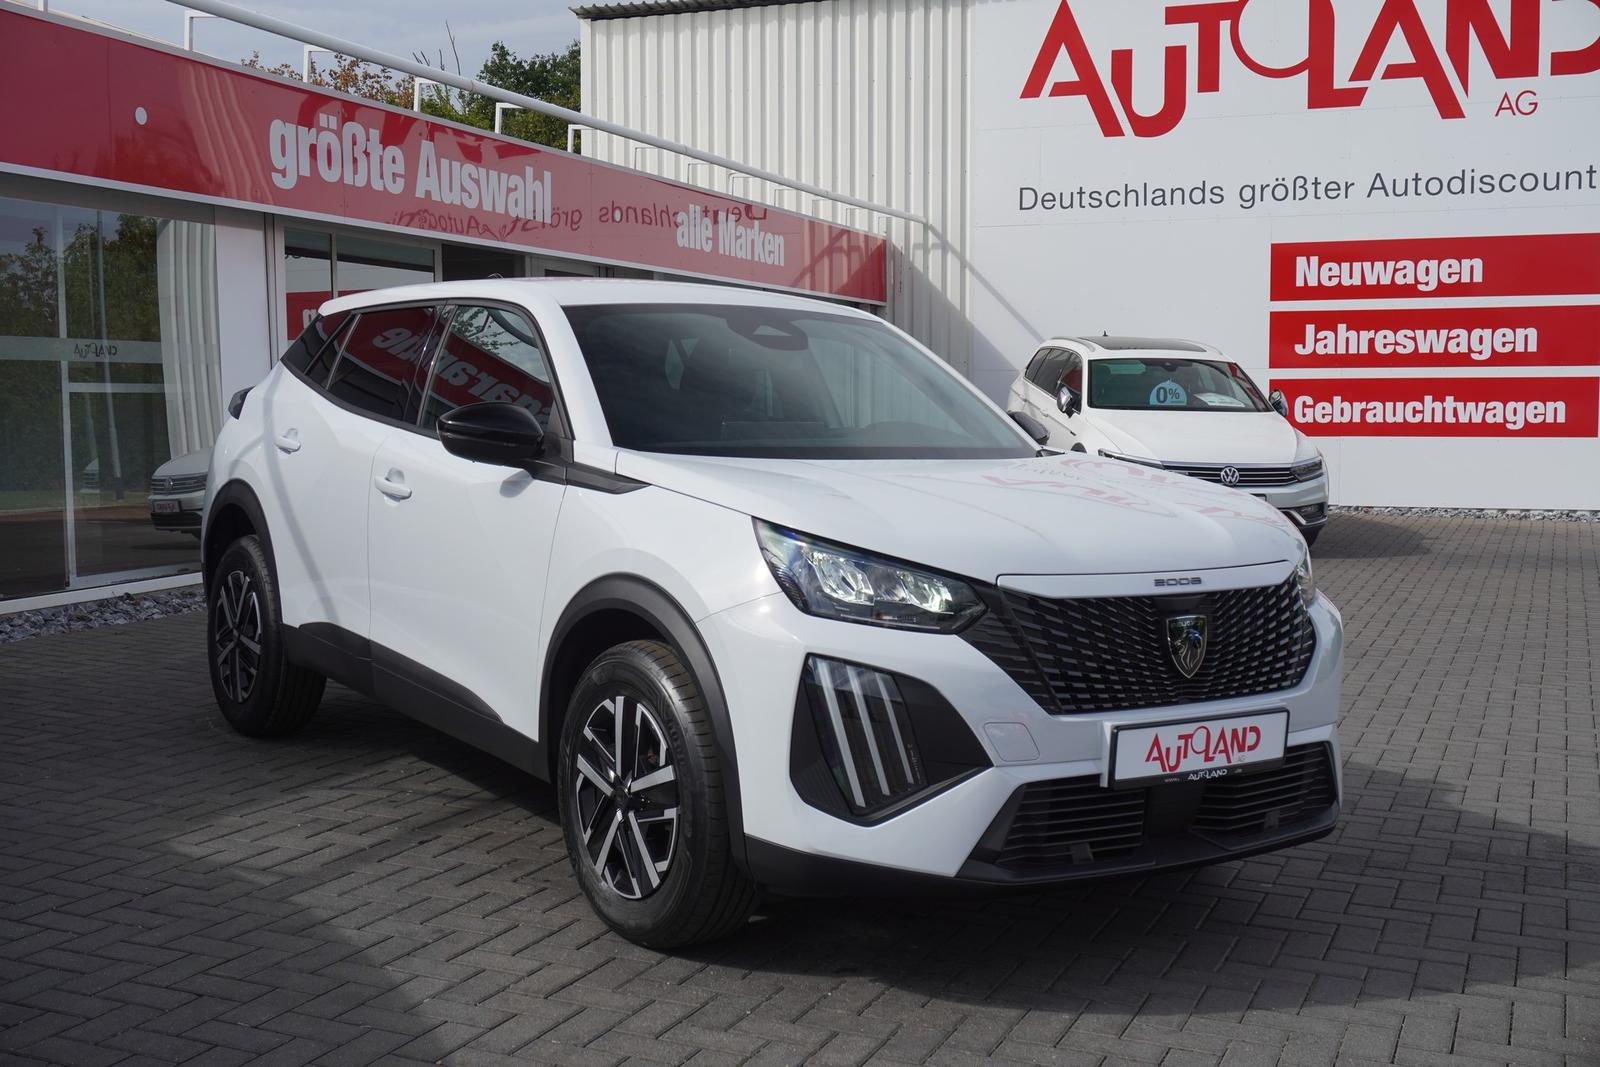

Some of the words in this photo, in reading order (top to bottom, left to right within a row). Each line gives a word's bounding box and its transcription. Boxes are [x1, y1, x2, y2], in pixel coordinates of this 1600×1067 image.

[1495, 90, 1538, 117] AG
[269, 113, 405, 194] größte
[415, 140, 552, 224] Auswahl
[1019, 181, 1224, 211] Deutschlands
[1240, 175, 1355, 209] größter
[1367, 165, 1597, 198] Autodiscount
[676, 204, 713, 253] alle
[718, 211, 785, 267] Marken
[1295, 255, 1483, 291] Neuwagen
[1294, 324, 1538, 361] Jahreswagen
[1156, 386, 1180, 404] 0%
[1294, 395, 1566, 431] Gebrauchtwagen
[1154, 577, 1202, 587] 2008
[1144, 726, 1262, 773] AUTOLAND
